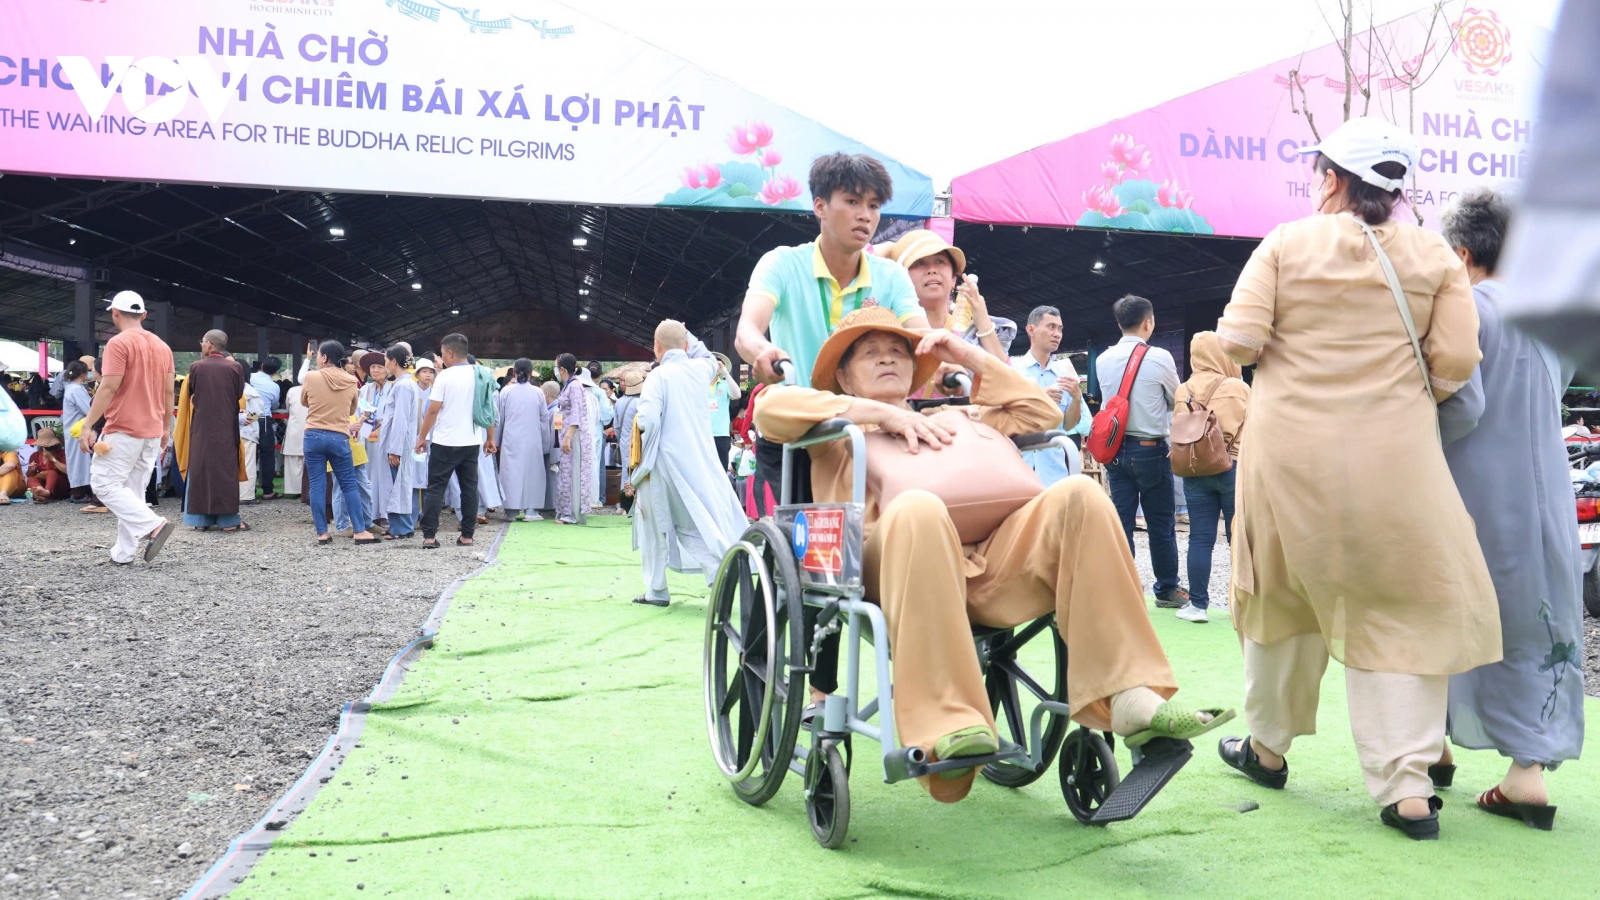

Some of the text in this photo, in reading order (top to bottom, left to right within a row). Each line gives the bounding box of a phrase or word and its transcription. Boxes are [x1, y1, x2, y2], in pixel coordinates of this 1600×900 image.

[249, 4, 334, 17] HO CHI MINH CITY
[198, 22, 388, 66] NHÀ CHỜ
[1453, 78, 1503, 95] VESAK
[262, 71, 387, 110] CHIÊM
[402, 78, 463, 115] BÁI
[476, 84, 530, 120] XÁ
[545, 93, 600, 131] LỢI
[614, 96, 705, 138] PHẬT
[0, 108, 39, 129] THE
[153, 118, 216, 140] AREA
[222, 122, 267, 143] FOR
[273, 126, 310, 145] THE
[318, 129, 410, 151] BUDDHA
[416, 134, 474, 155] RELIC
[480, 138, 575, 161] PILGRIMS
[1423, 108, 1531, 143] NHÀ CH
[1179, 127, 1266, 162] DÀNH
[795, 524, 806, 547] 04
[814, 517, 840, 529] AGRIBANK
